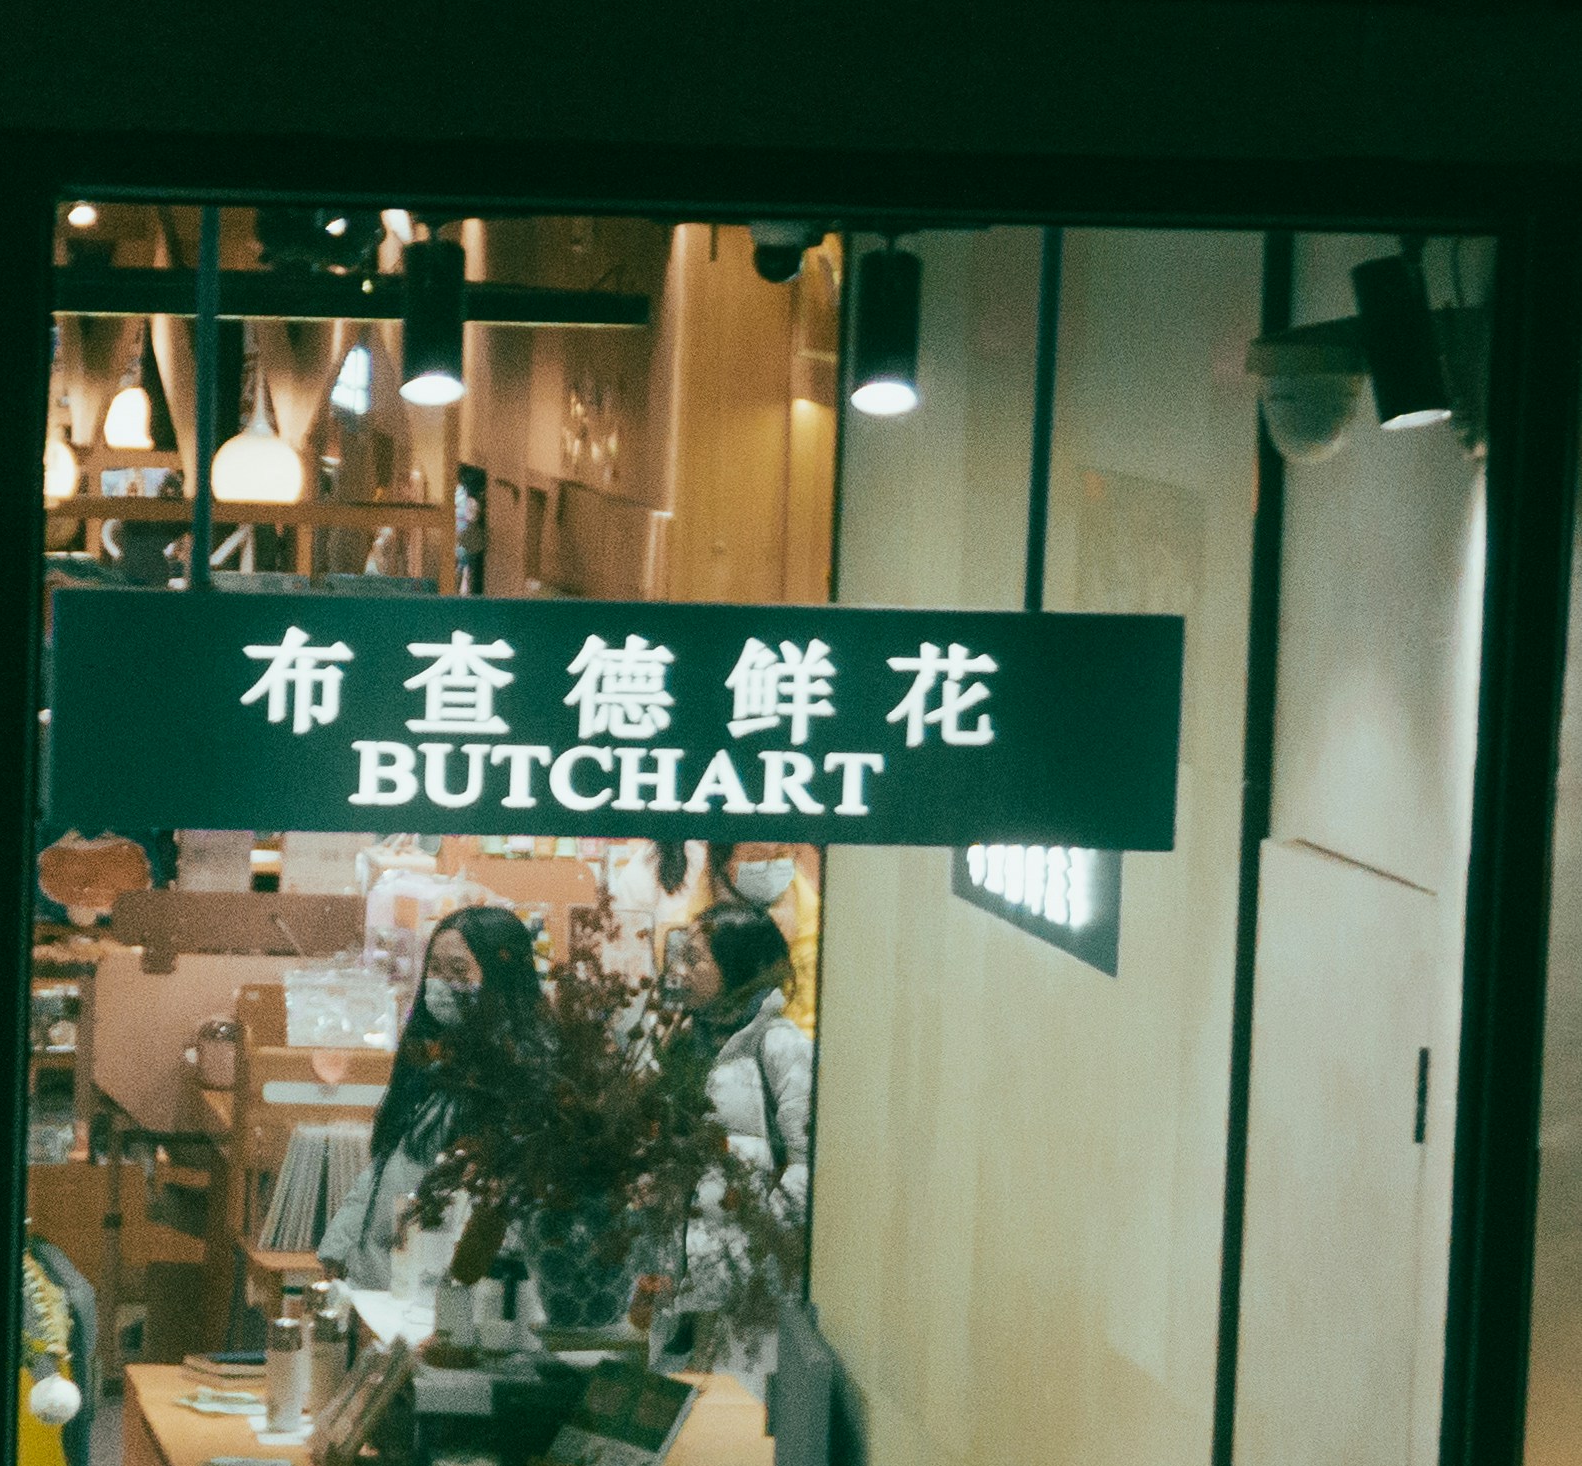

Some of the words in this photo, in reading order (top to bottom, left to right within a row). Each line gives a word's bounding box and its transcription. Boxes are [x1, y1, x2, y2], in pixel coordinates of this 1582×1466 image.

[239, 624, 999, 748] 布查德鲜花
[347, 740, 885, 816] BUTCHART
